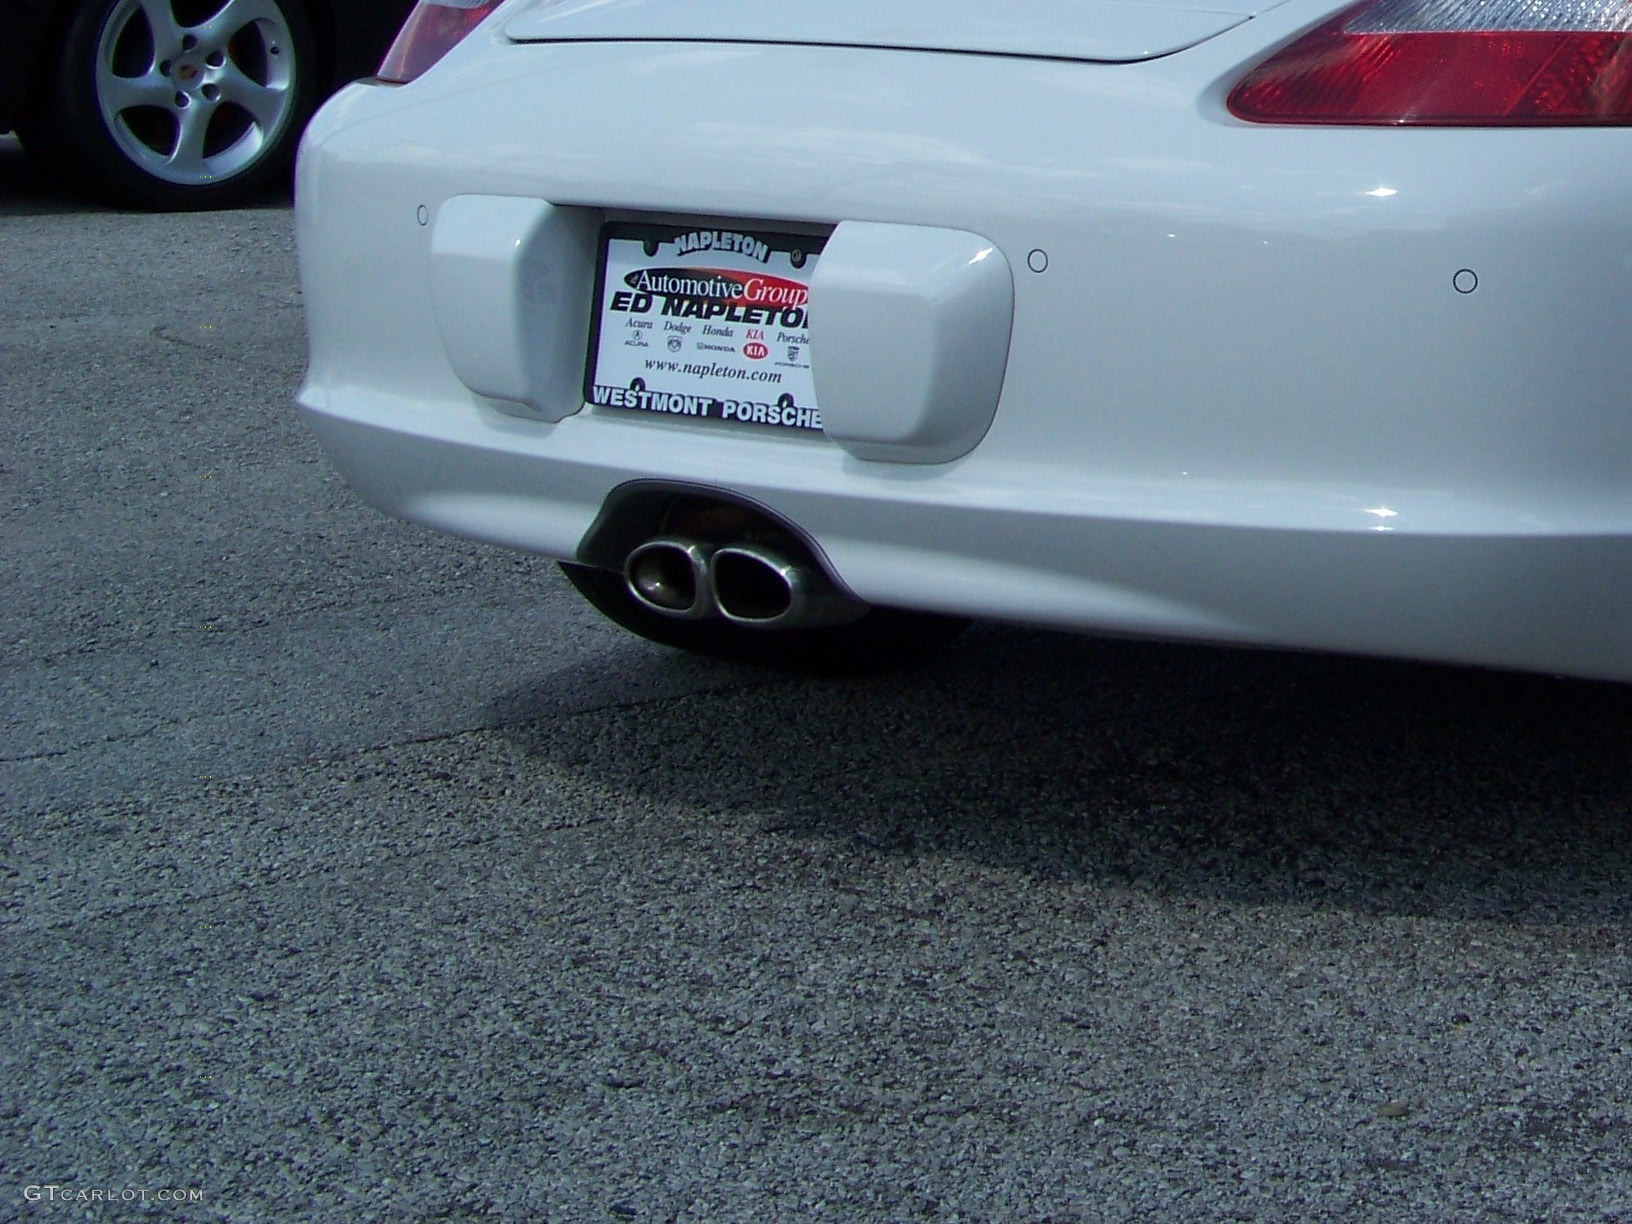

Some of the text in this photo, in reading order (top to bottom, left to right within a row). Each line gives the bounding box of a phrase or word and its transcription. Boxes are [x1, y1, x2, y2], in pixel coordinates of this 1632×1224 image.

[674, 231, 768, 263] NAPLETON
[610, 291, 809, 330] ED NAPLETO
[625, 317, 653, 330] Acura
[663, 320, 692, 335] Dodge
[702, 324, 734, 337] Honda
[745, 329, 765, 340] KIA
[746, 345, 766, 357] KIA
[645, 359, 782, 383] www.napleton.com
[593, 386, 823, 429] WESTMONT PORSCHE
